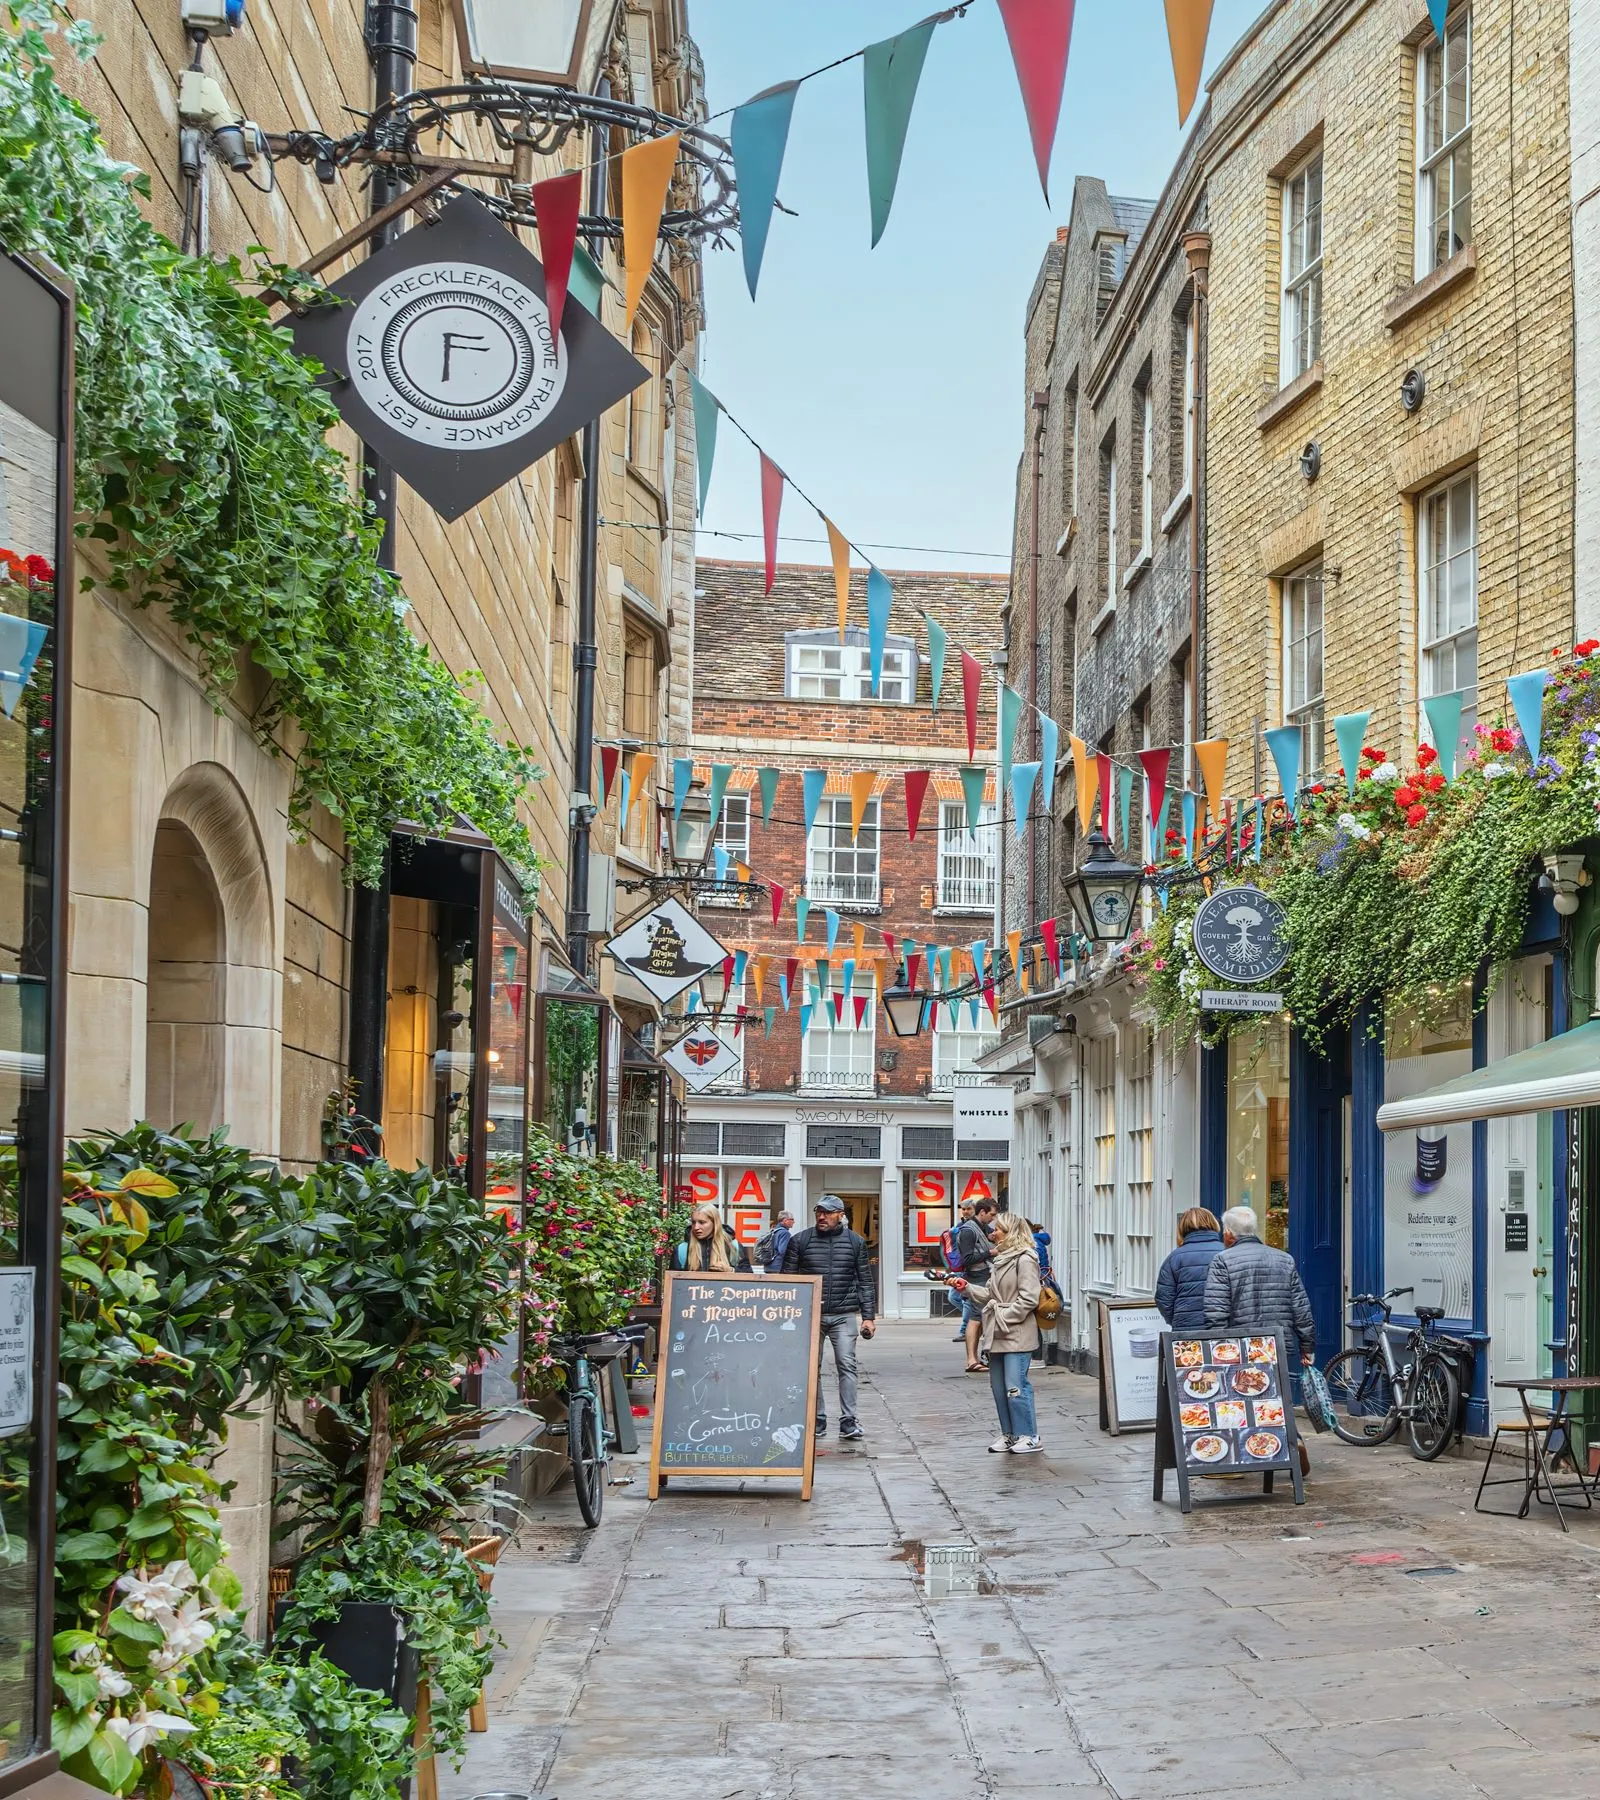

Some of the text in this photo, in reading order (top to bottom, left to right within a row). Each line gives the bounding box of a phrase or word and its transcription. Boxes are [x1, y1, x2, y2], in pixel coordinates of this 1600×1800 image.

[379, 270, 559, 442] FRECKLEFACE HOME FRAGRANCE
[357, 334, 419, 430] EST. 2017
[1202, 894, 1248, 928] NEAL'S
[661, 926, 675, 935] The
[1205, 944, 1284, 976] REMEDIES
[1208, 998, 1277, 1007] THERAPY ROOM
[795, 1108, 895, 1124] Sweaty Betty
[1570, 1111, 1579, 1189] ish
[1407, 1213, 1457, 1226] Redefine your age
[688, 1286, 798, 1303] The Department
[681, 1305, 803, 1323] of Magical Gifts
[704, 1323, 768, 1344] Accio
[687, 1406, 773, 1442] Cornetto!
[666, 1442, 733, 1453] ICE COLD
[665, 1452, 716, 1463] BUTTER
